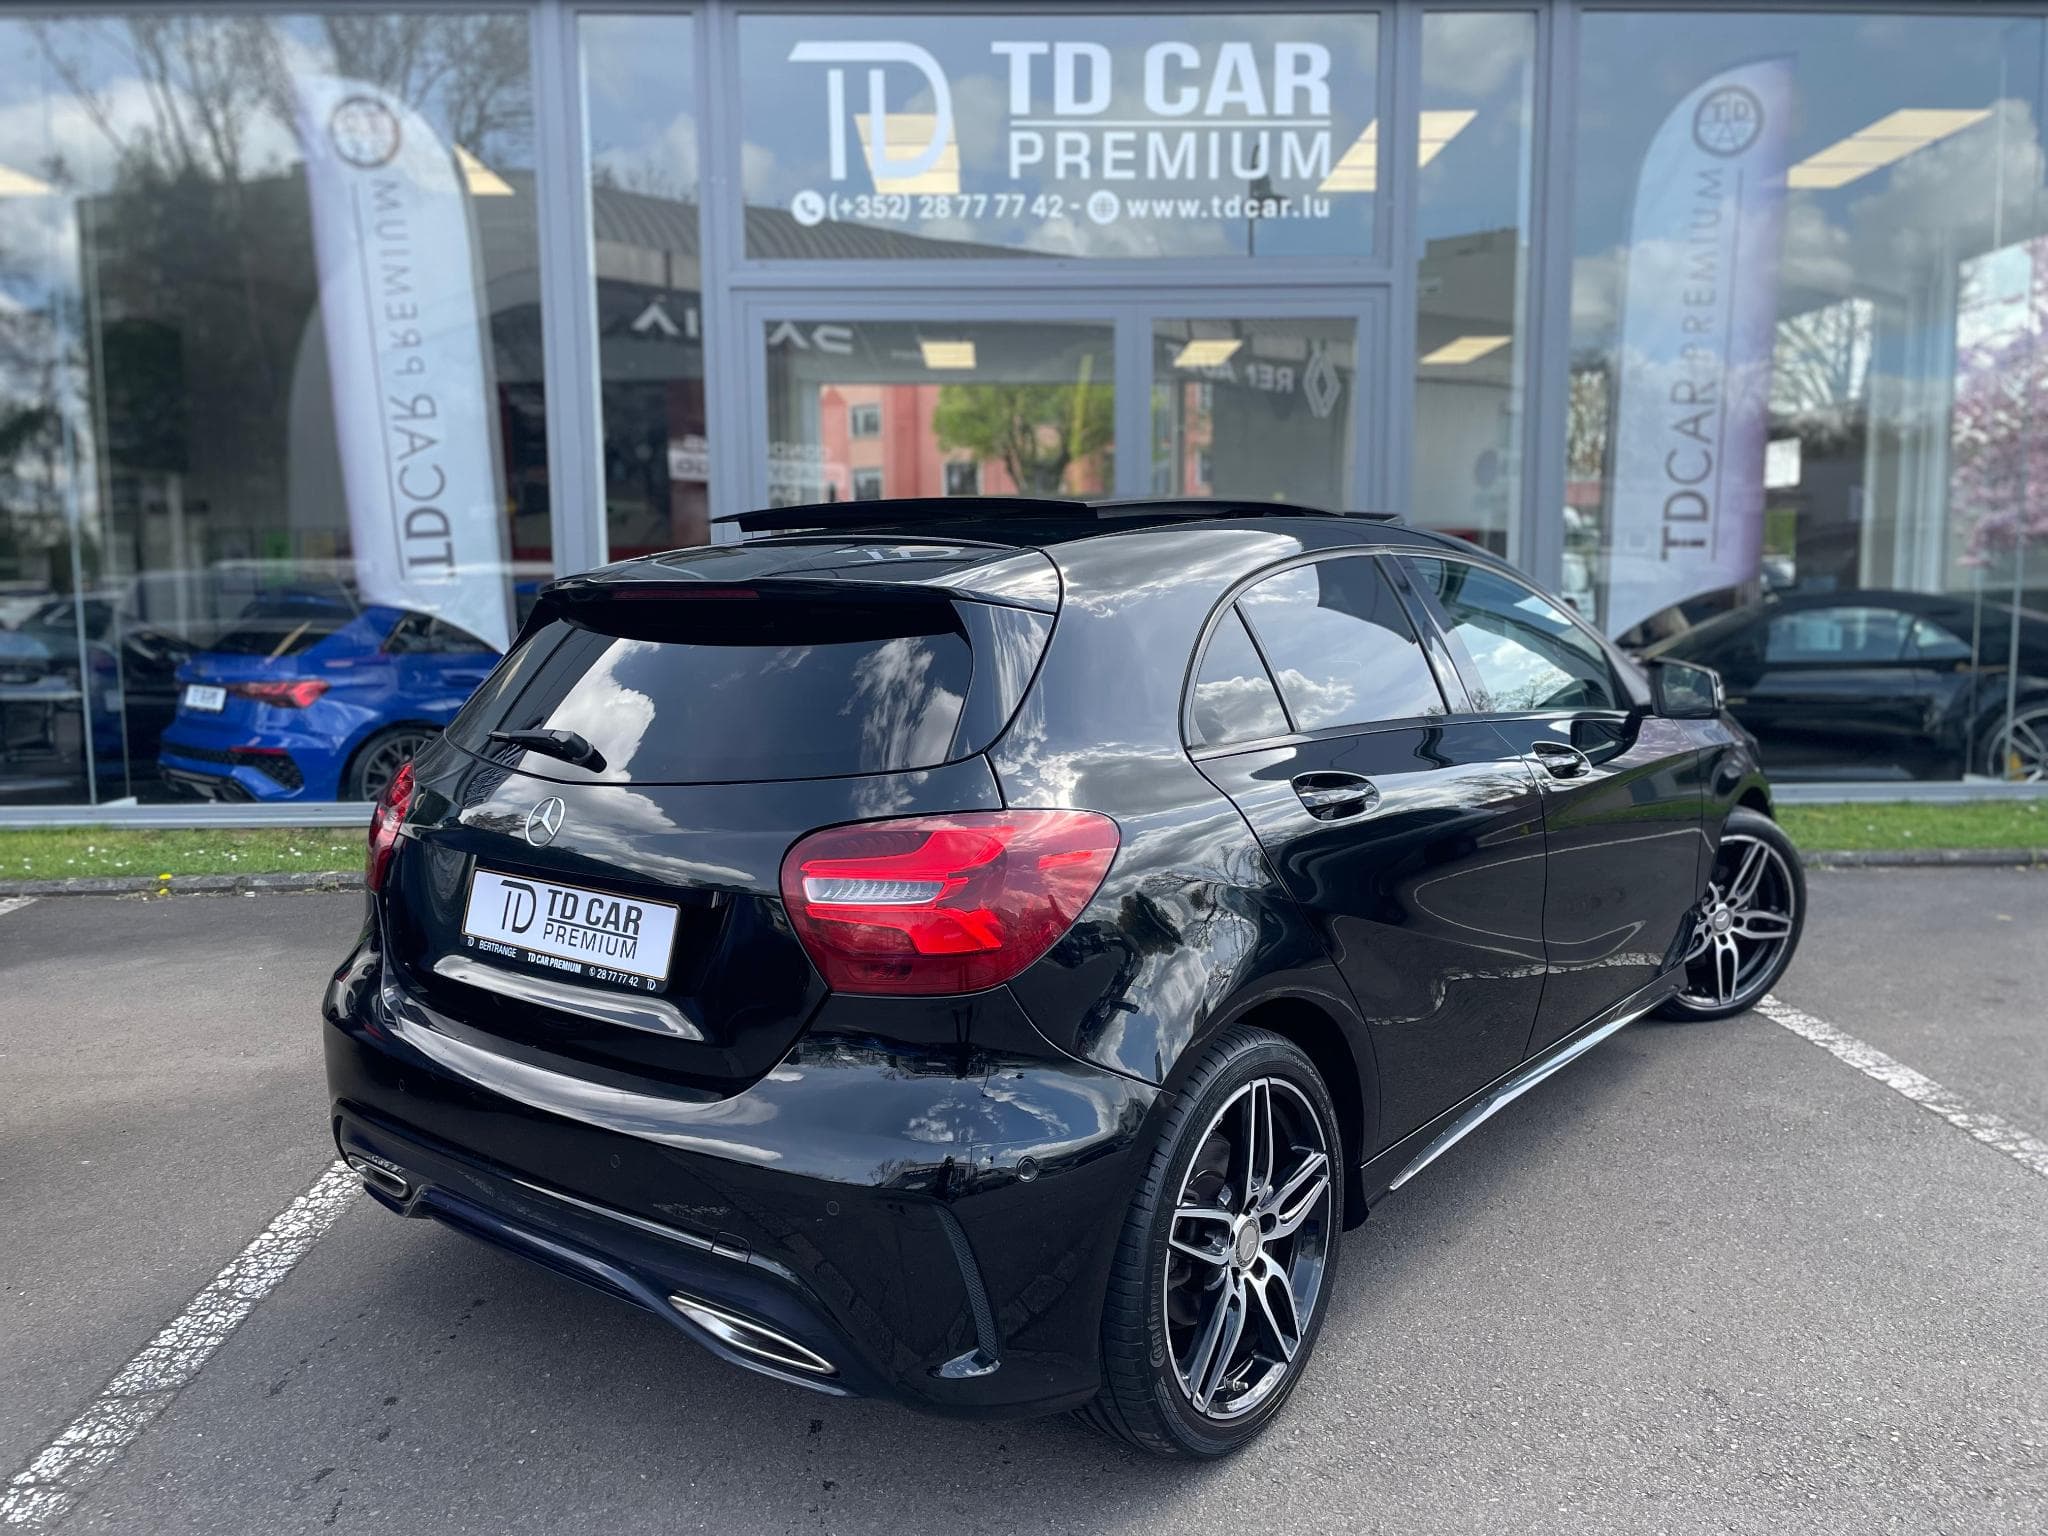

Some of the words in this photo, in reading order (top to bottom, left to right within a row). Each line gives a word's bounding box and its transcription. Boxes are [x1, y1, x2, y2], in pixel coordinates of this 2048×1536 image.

[991, 42, 1112, 115] TD
[1144, 41, 1331, 116] CAR
[1009, 131, 1331, 180] PREMIUM
[829, 194, 911, 221] (+352)
[1126, 195, 1331, 219] www.tdcar.lu
[1679, 167, 1724, 359] PREMIUM
[547, 888, 579, 921] TD
[585, 897, 643, 936] CAR
[479, 940, 518, 958] BERTRANGE
[528, 952, 536, 963] TD
[536, 955, 549, 967] CAR
[549, 957, 582, 974] PREMIUM
[628, 975, 639, 987] 42
[543, 922, 638, 960] PREMIUM
